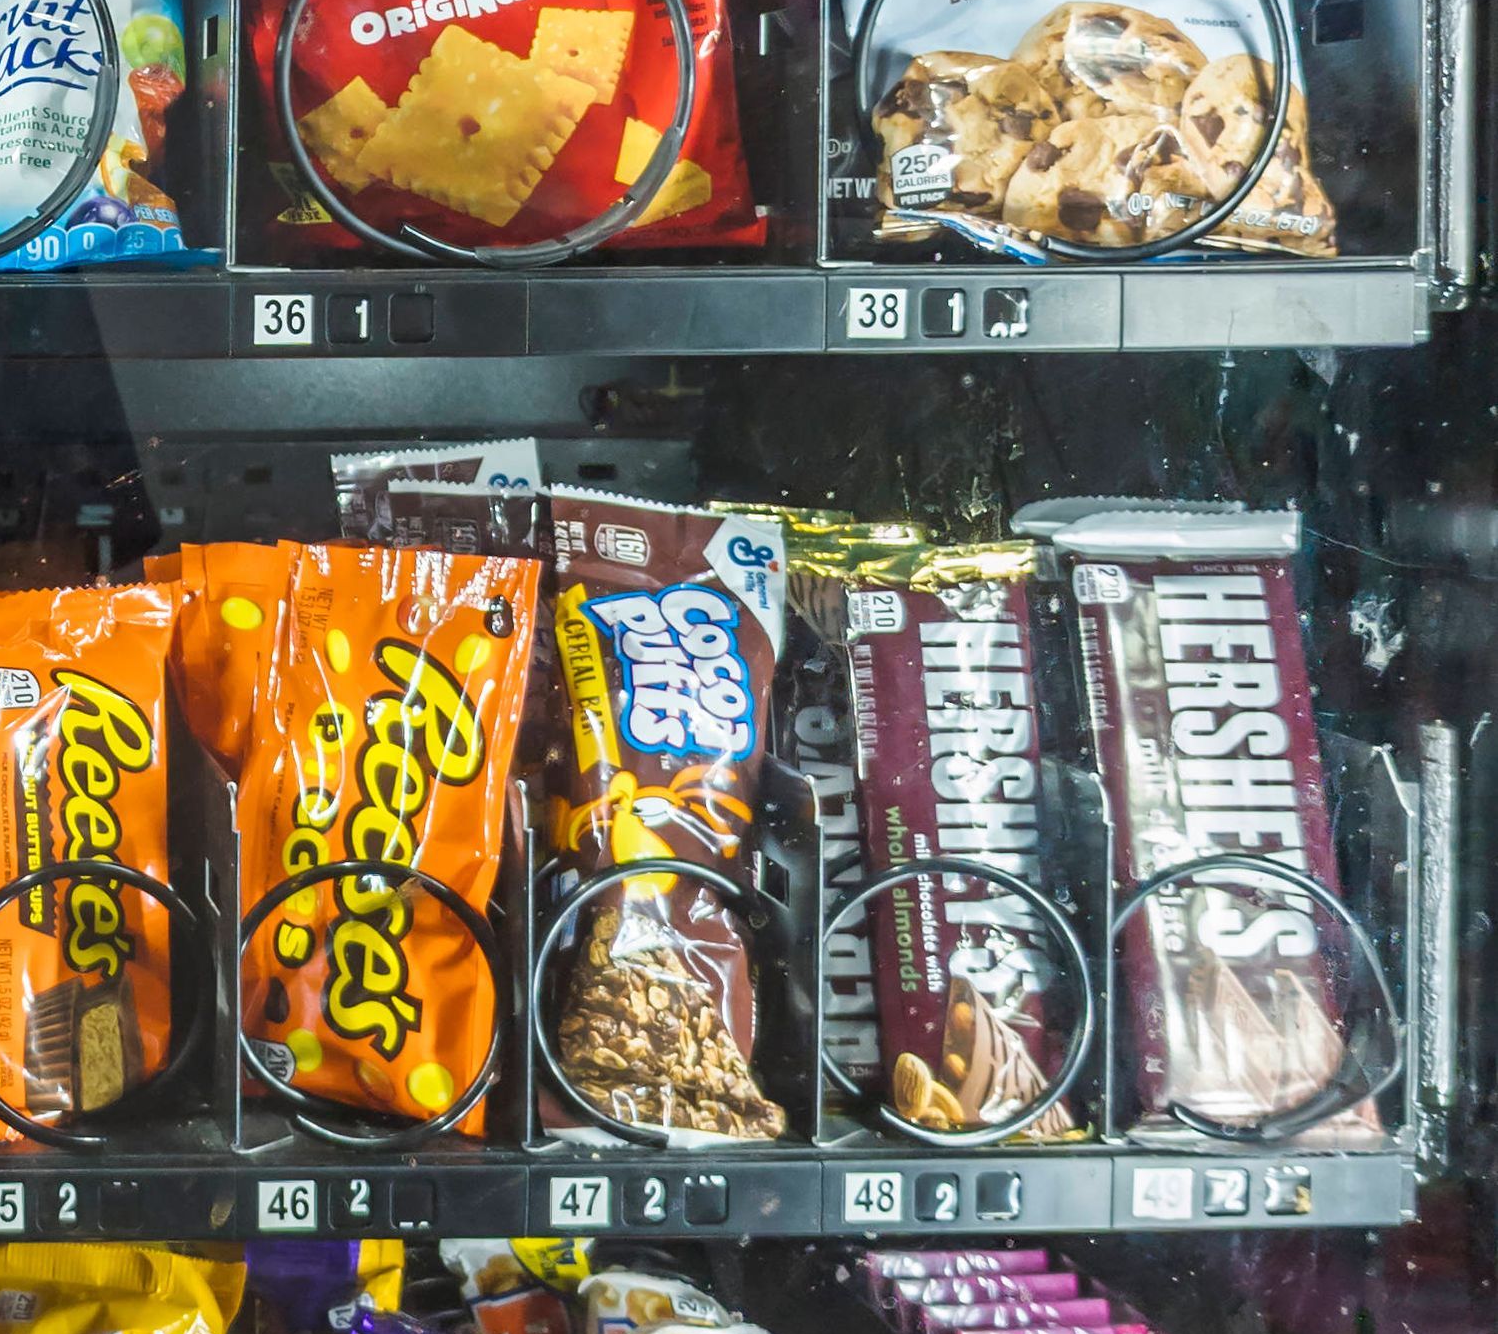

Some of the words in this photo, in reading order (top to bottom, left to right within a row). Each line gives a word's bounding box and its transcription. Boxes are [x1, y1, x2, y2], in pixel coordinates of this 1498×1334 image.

[19, 151, 52, 169] Free
[898, 153, 942, 176] 250
[895, 172, 950, 189] CALORIES
[900, 192, 918, 206] PER
[920, 190, 946, 204] PACK
[27, 235, 60, 263] 90
[264, 301, 307, 335] 36
[857, 292, 900, 329] 38
[615, 531, 646, 564] 160
[755, 572, 771, 610] General
[871, 593, 895, 629] 210
[562, 618, 598, 691] CEREAL
[10, 671, 35, 707] 210
[1153, 575, 1319, 957] HERSHEY'S
[918, 873, 940, 947] chocolate
[891, 887, 919, 994] almonds
[924, 949, 945, 994] with
[267, 1186, 310, 1222] 46
[559, 1184, 602, 1219] 47
[852, 1178, 895, 1213] 48
